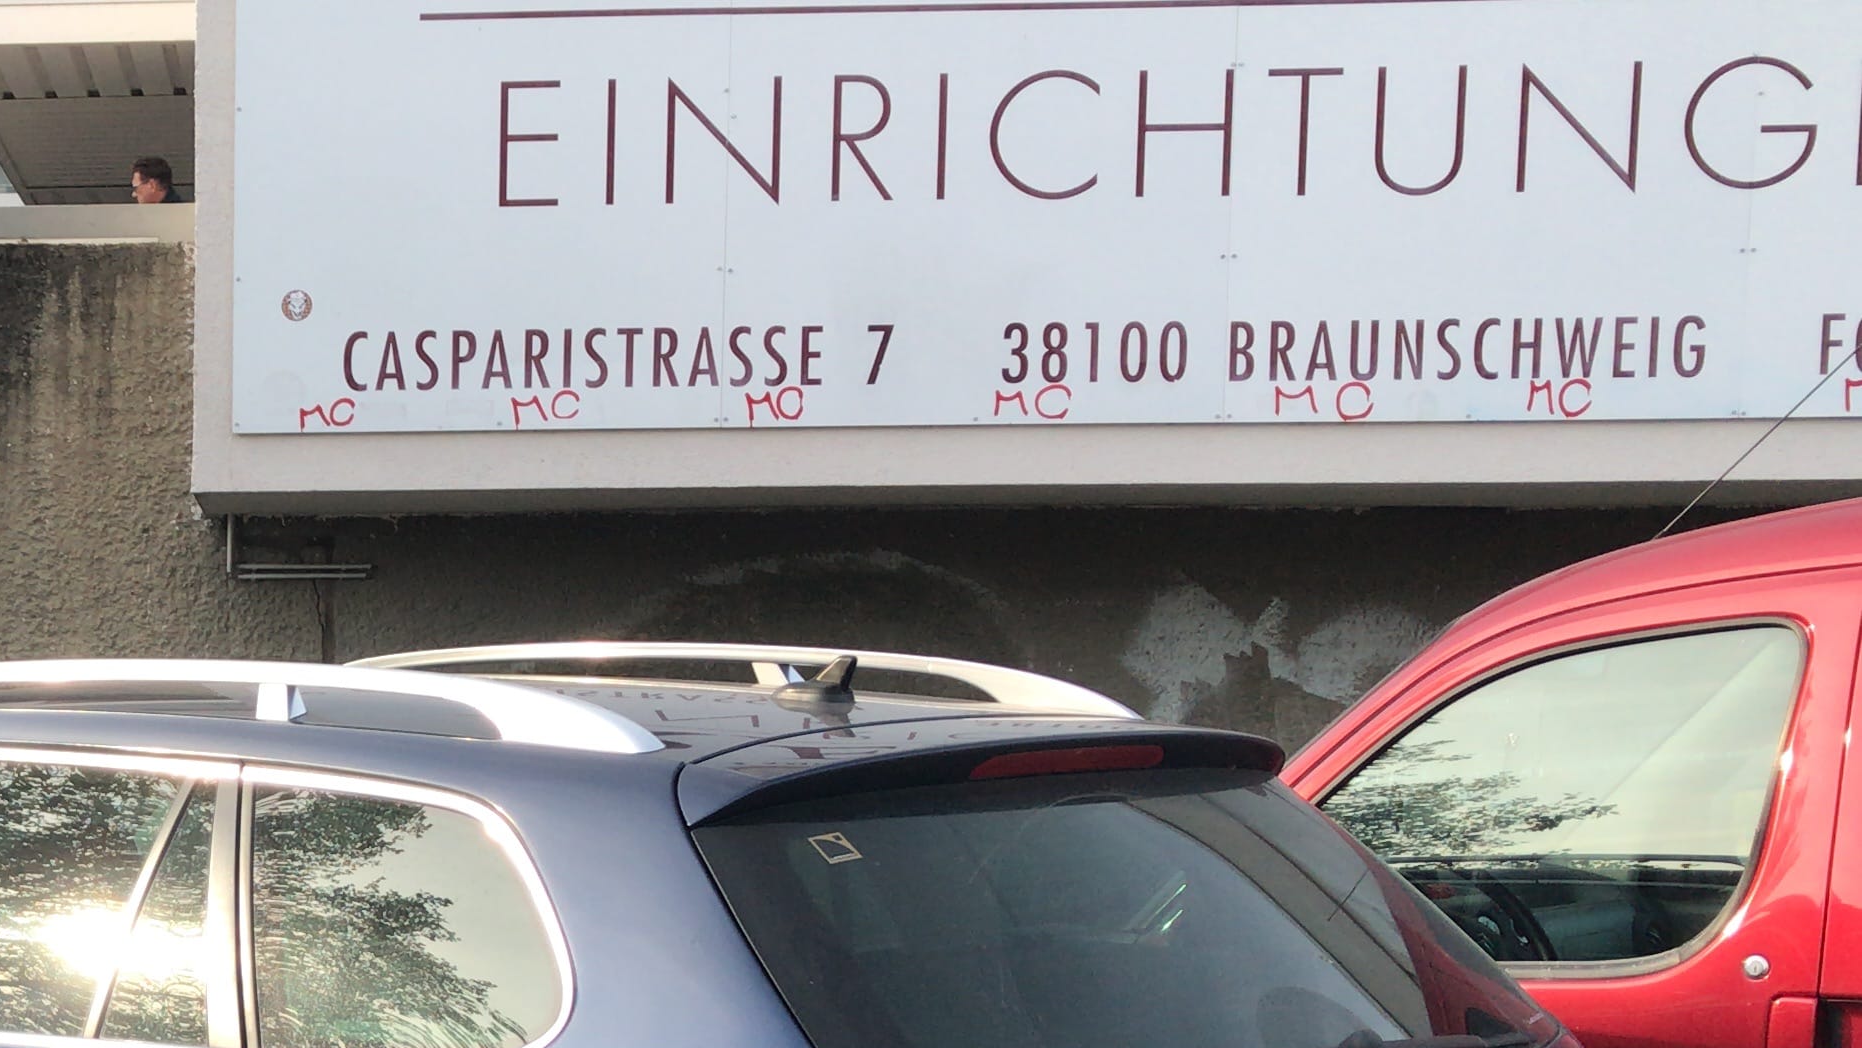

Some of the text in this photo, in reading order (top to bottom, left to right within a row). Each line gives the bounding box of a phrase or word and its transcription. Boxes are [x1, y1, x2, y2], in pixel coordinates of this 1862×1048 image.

[498, 56, 1862, 207] EINRICHTUNG
[342, 312, 1862, 391] CASPARISTRASSE 7 38100 BRAUNSCHWEIG F
